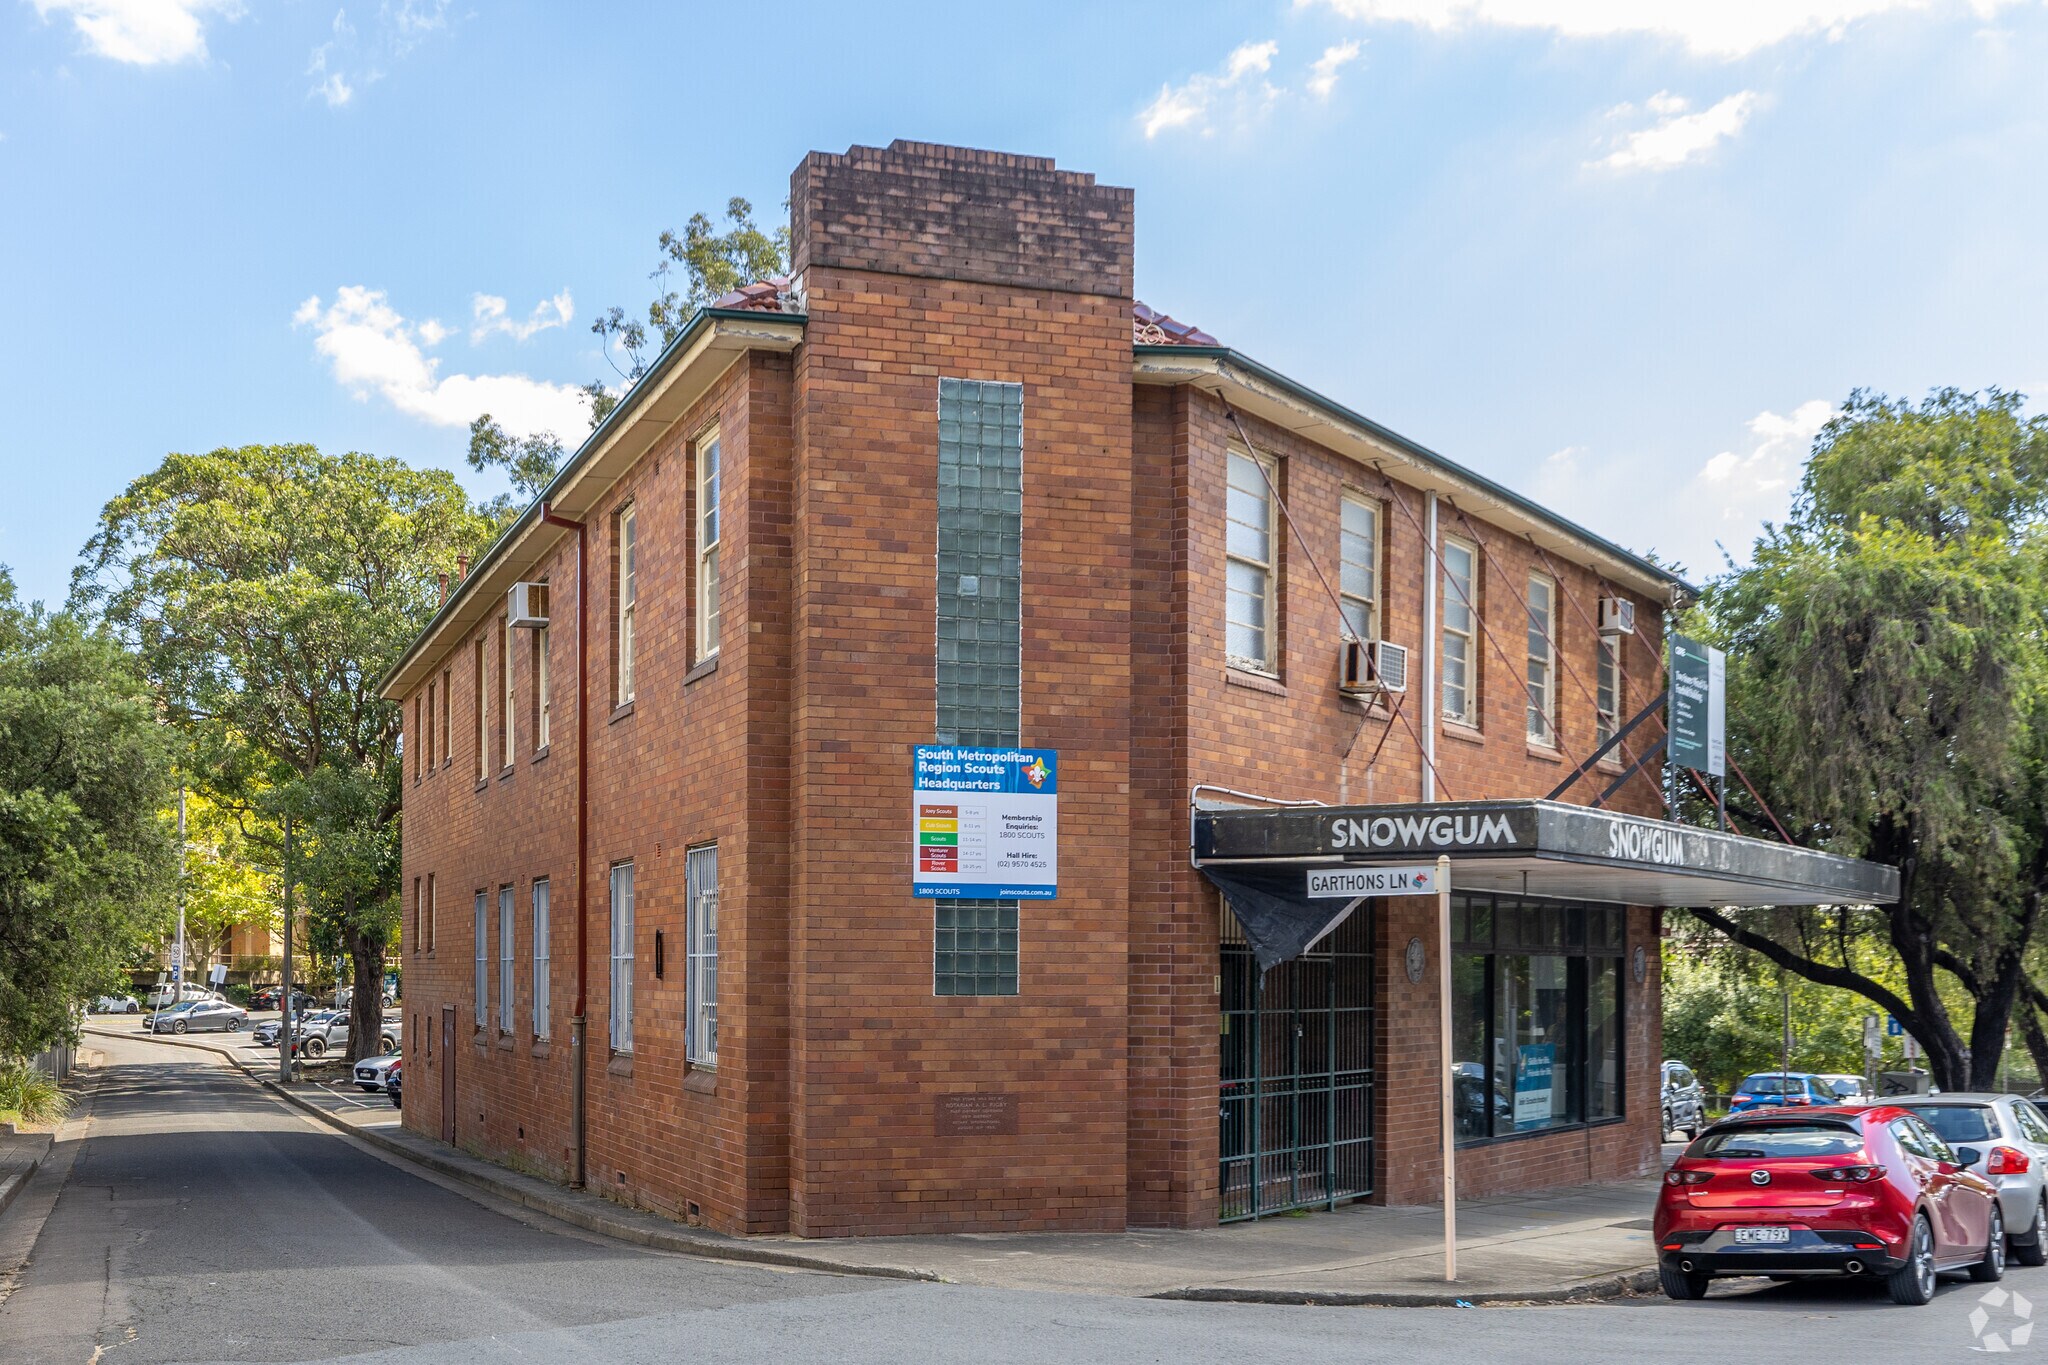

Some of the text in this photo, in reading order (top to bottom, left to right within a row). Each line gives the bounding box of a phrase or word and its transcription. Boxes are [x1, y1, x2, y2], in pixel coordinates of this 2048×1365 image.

[918, 748, 1033, 764] South Metropolitan
[919, 761, 1005, 775] Region Scouts
[918, 777, 1001, 791] Headquarters
[1002, 814, 1043, 823] Membership
[1006, 823, 1039, 831] Enquiries:
[1331, 813, 1518, 849] SNOWGUM
[1609, 821, 1684, 865] SNOWGUM
[1311, 873, 1408, 891] GARTHONS LN
